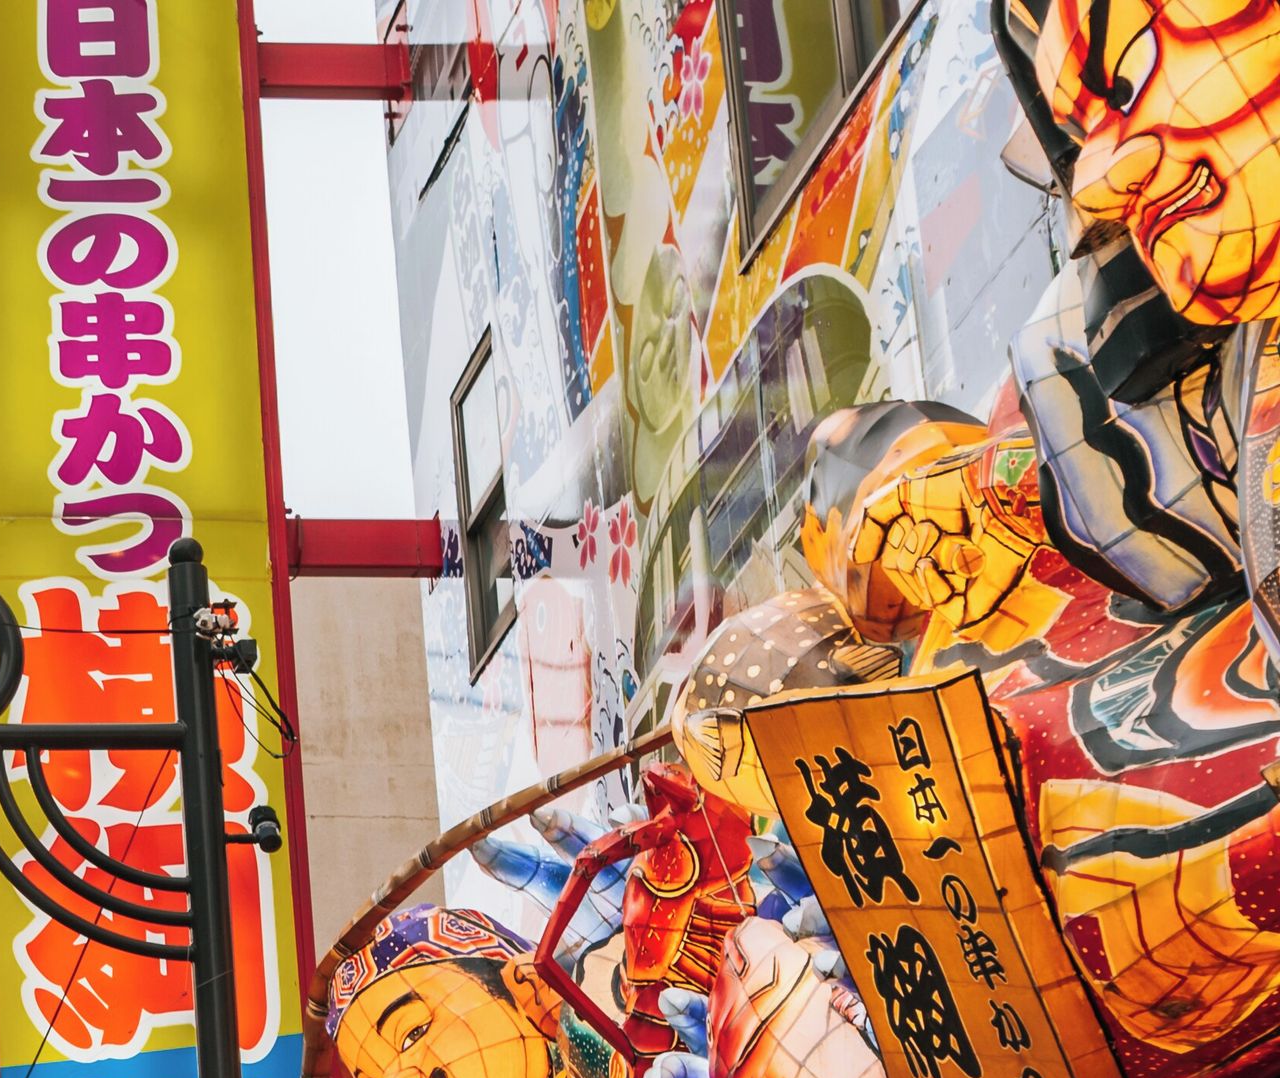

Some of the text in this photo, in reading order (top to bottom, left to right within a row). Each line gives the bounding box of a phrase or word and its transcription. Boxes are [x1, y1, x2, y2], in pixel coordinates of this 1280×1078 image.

[40, 0, 187, 573] 日本一の串かつ
